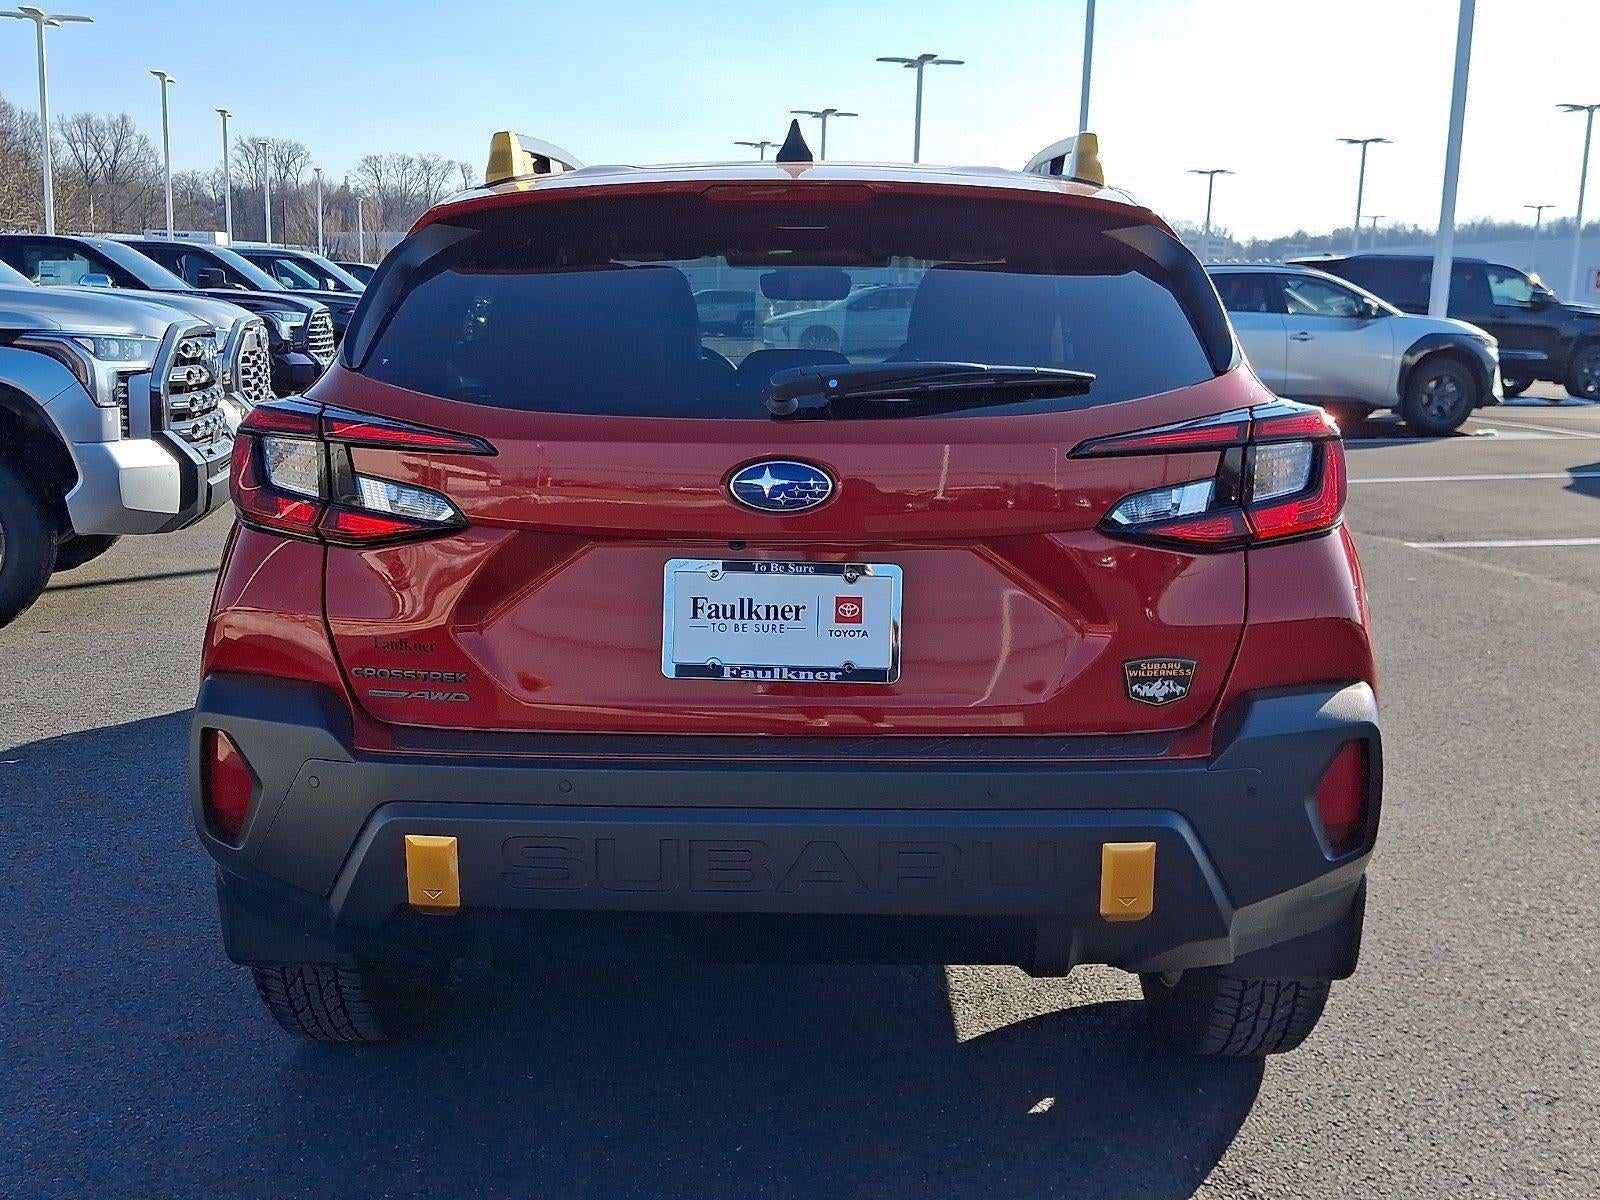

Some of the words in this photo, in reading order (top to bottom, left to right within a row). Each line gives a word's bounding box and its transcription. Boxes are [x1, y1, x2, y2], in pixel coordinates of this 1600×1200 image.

[752, 562, 767, 572] To
[770, 563, 785, 573] Be
[788, 563, 815, 574] Sure
[689, 596, 807, 622] Faulkner
[710, 622, 727, 633] TO
[734, 623, 748, 633] BE
[754, 623, 785, 634] SURE
[828, 629, 869, 638] TOYOTA
[373, 637, 436, 653] Faulkner
[1140, 662, 1181, 670] SUBARU
[351, 666, 470, 683] CROSSTREK
[722, 666, 843, 681] Faulkner
[1129, 669, 1192, 677] WILDERNESS
[406, 690, 470, 702] AWD
[500, 835, 1058, 895] SUBARU
